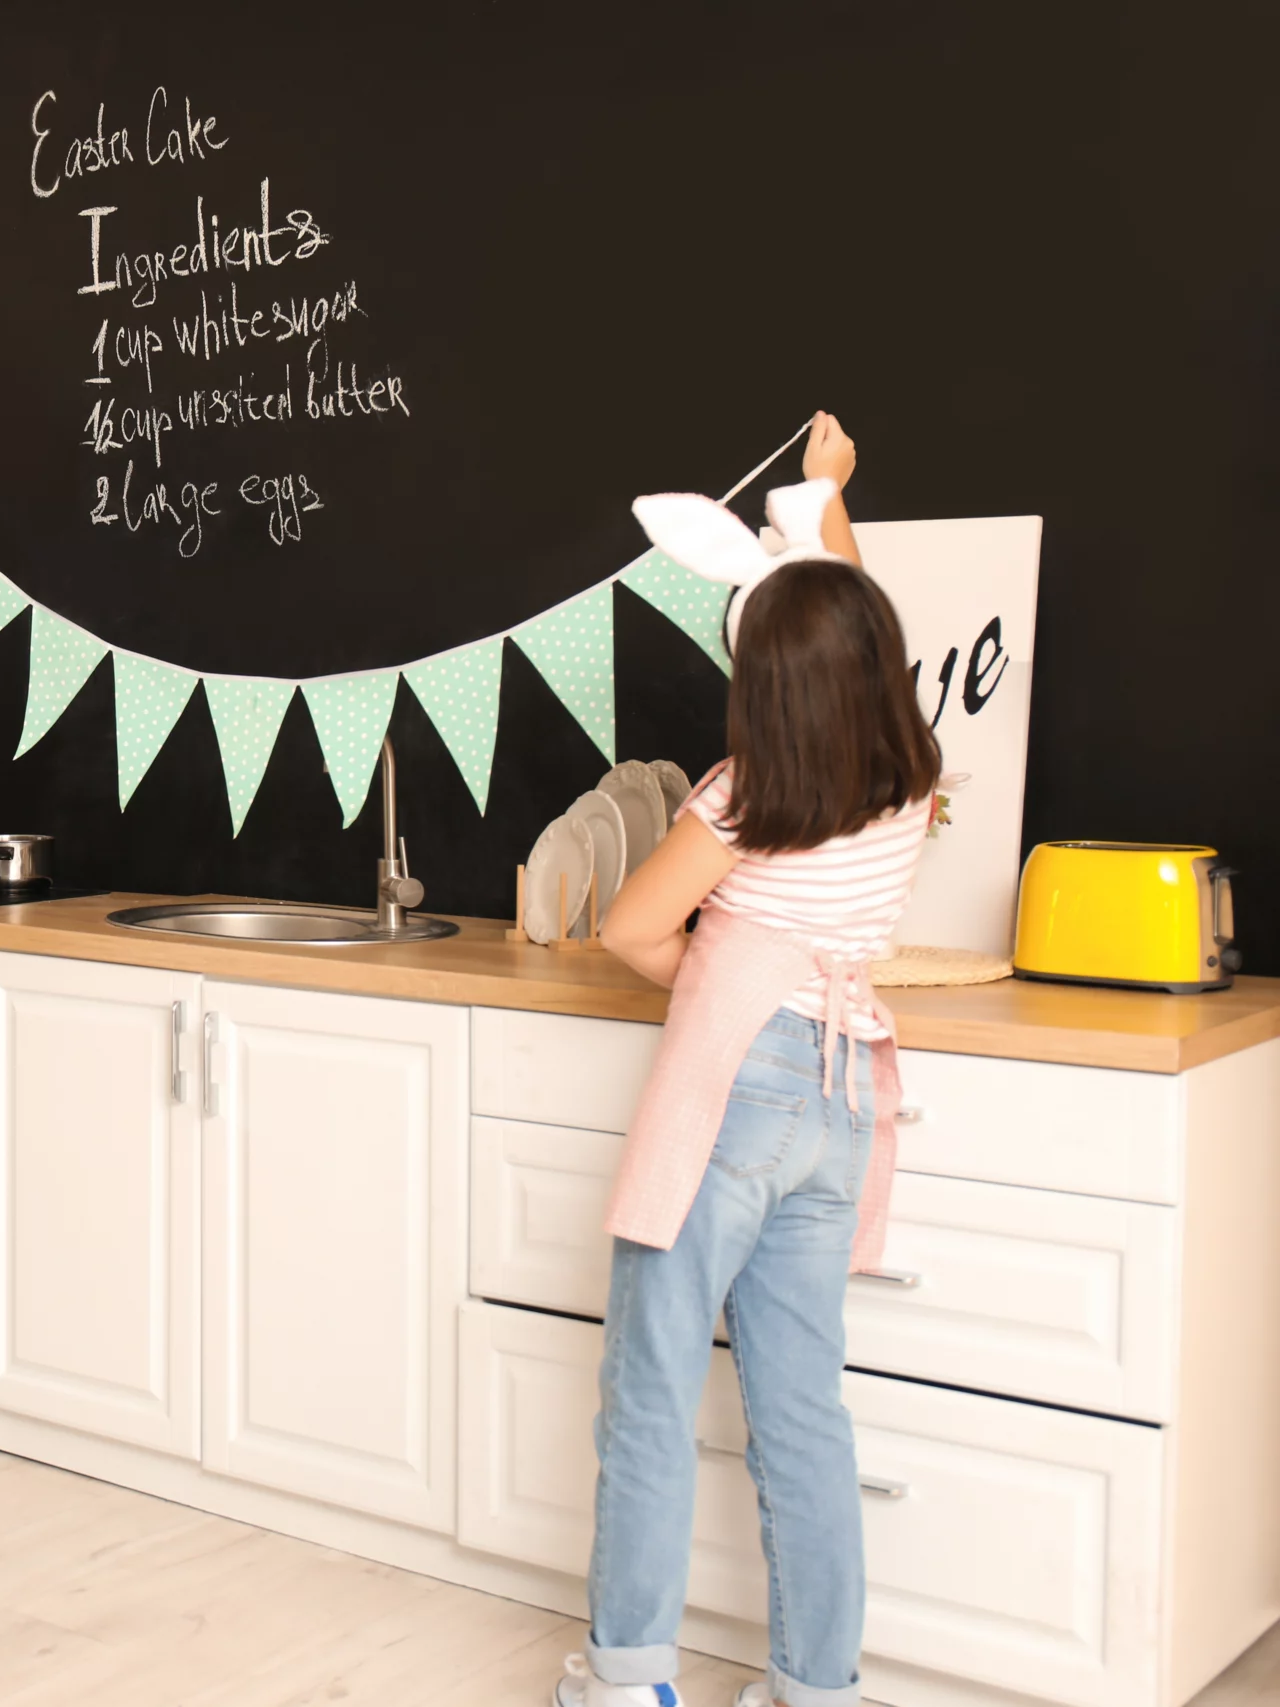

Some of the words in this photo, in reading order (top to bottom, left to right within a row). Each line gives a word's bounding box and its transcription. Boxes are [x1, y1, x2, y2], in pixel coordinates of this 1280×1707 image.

[31, 90, 133, 198] Easter
[147, 86, 229, 165] Cake
[77, 177, 334, 308] Ingredients
[84, 318, 112, 386] 1
[116, 325, 162, 393] cup
[173, 281, 270, 361] white
[271, 280, 368, 384] sugar
[121, 405, 173, 467] cup
[305, 361, 410, 420] butter
[90, 476, 118, 525] 2
[239, 474, 325, 546] eggs
